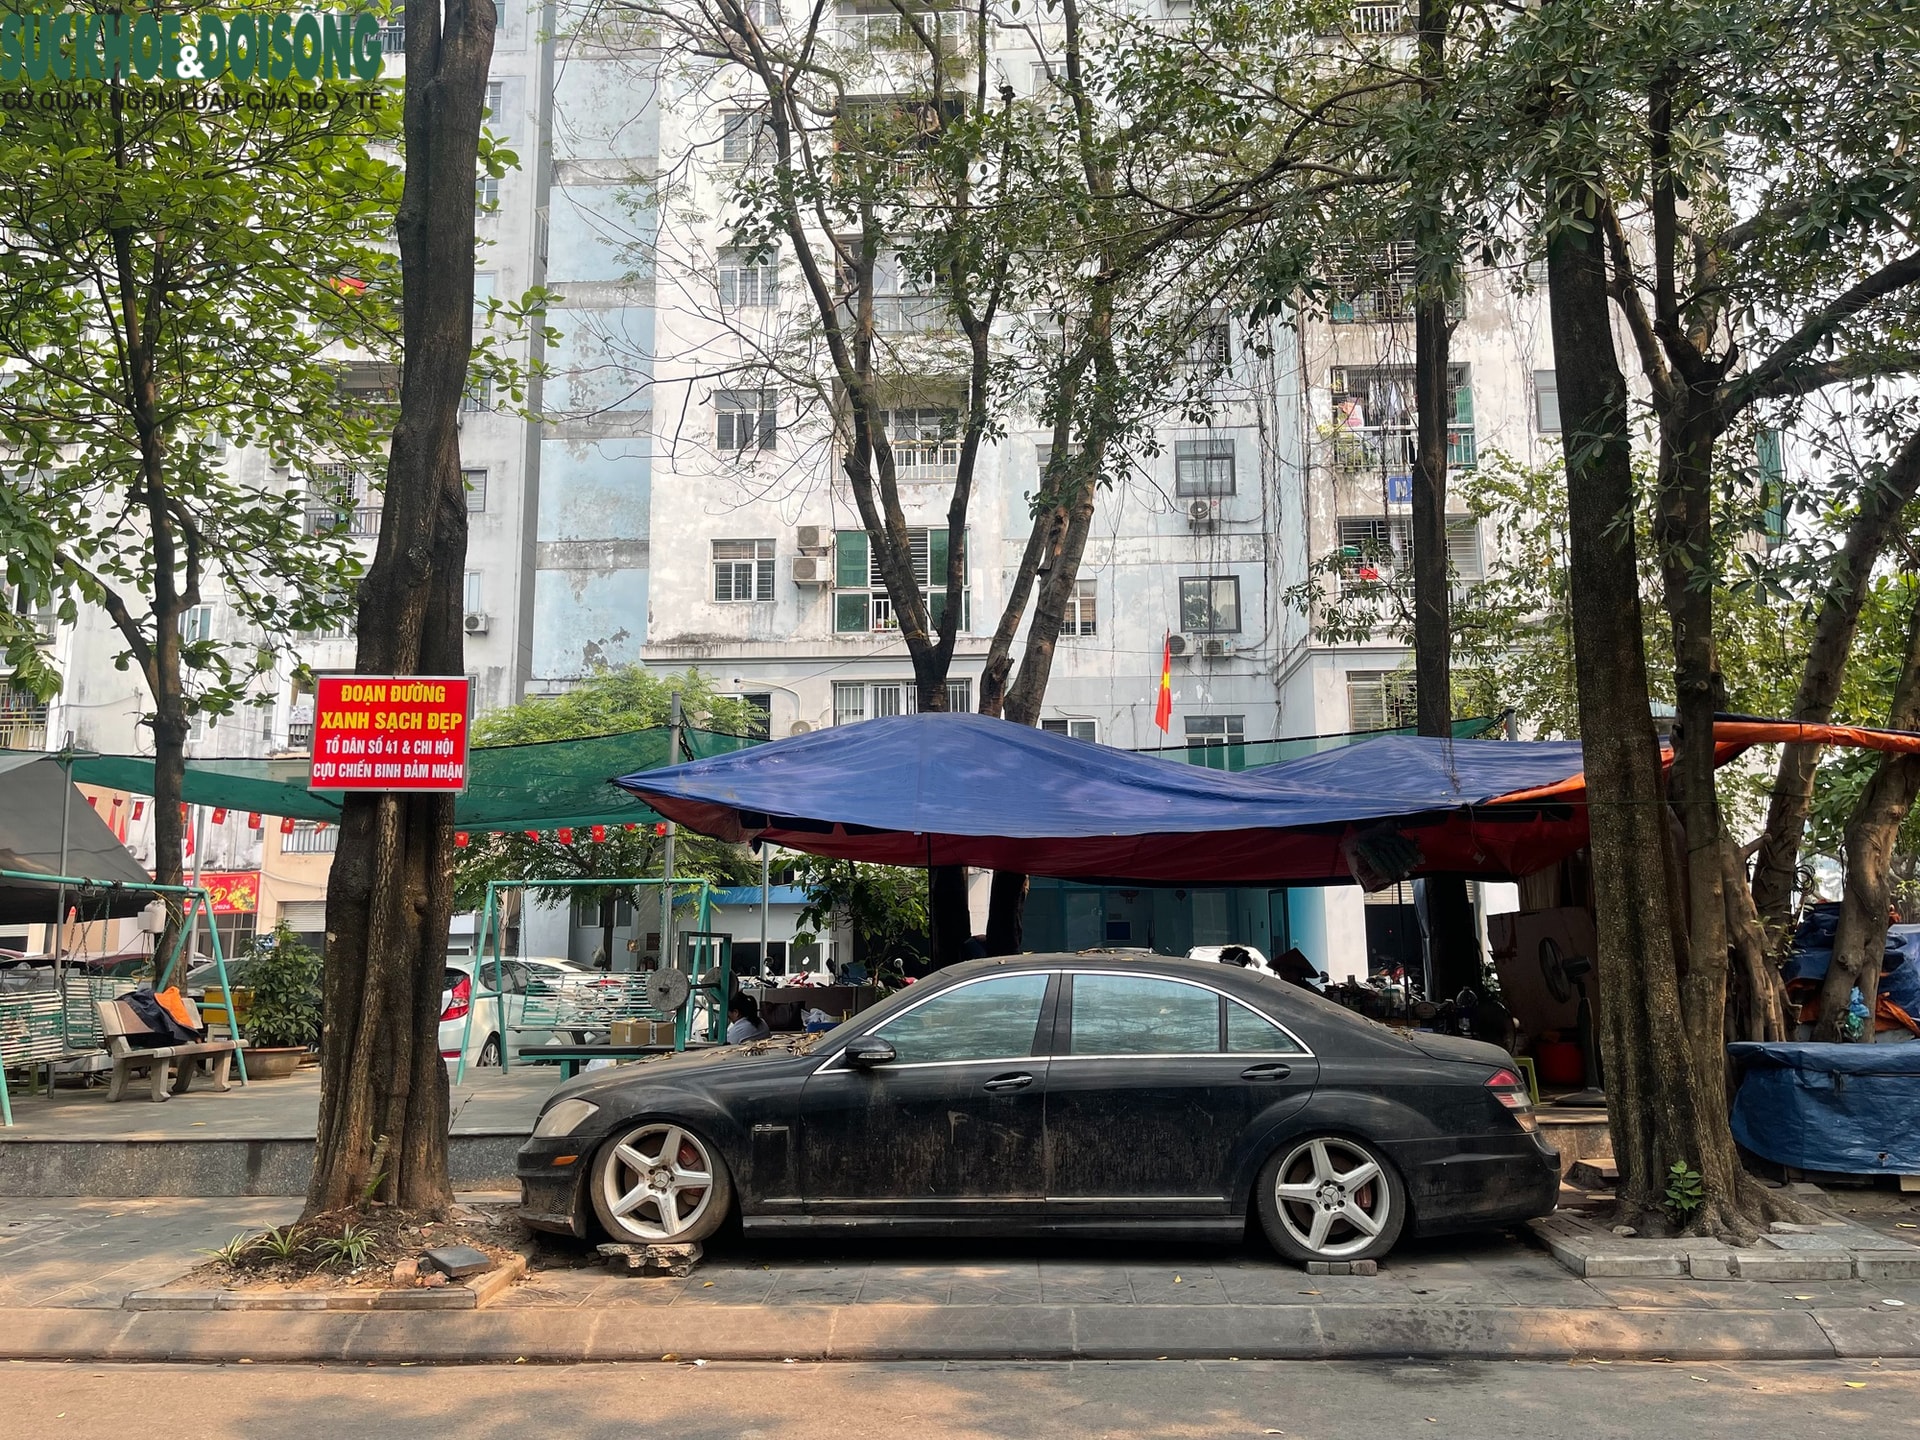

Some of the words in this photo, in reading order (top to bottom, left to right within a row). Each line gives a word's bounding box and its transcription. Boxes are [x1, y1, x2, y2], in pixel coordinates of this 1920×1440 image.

[341, 685, 386, 706] ĐOẠN
[390, 682, 446, 703] ĐƯỜNG
[321, 711, 370, 729] XANH
[374, 711, 422, 733] SẠCH
[427, 712, 463, 734] ĐẸP
[326, 735, 341, 754] TỔ
[342, 737, 365, 754] DÂN
[368, 735, 384, 754] SỐ
[385, 740, 398, 754] 41
[402, 740, 410, 754] &
[414, 740, 432, 754] CHI
[435, 738, 454, 757] HỘI
[313, 762, 336, 780] CỰU
[338, 760, 371, 778] CHIẾN
[374, 763, 401, 778] BINH
[404, 760, 429, 778] ĐẢM
[432, 762, 463, 781] NHẬN
